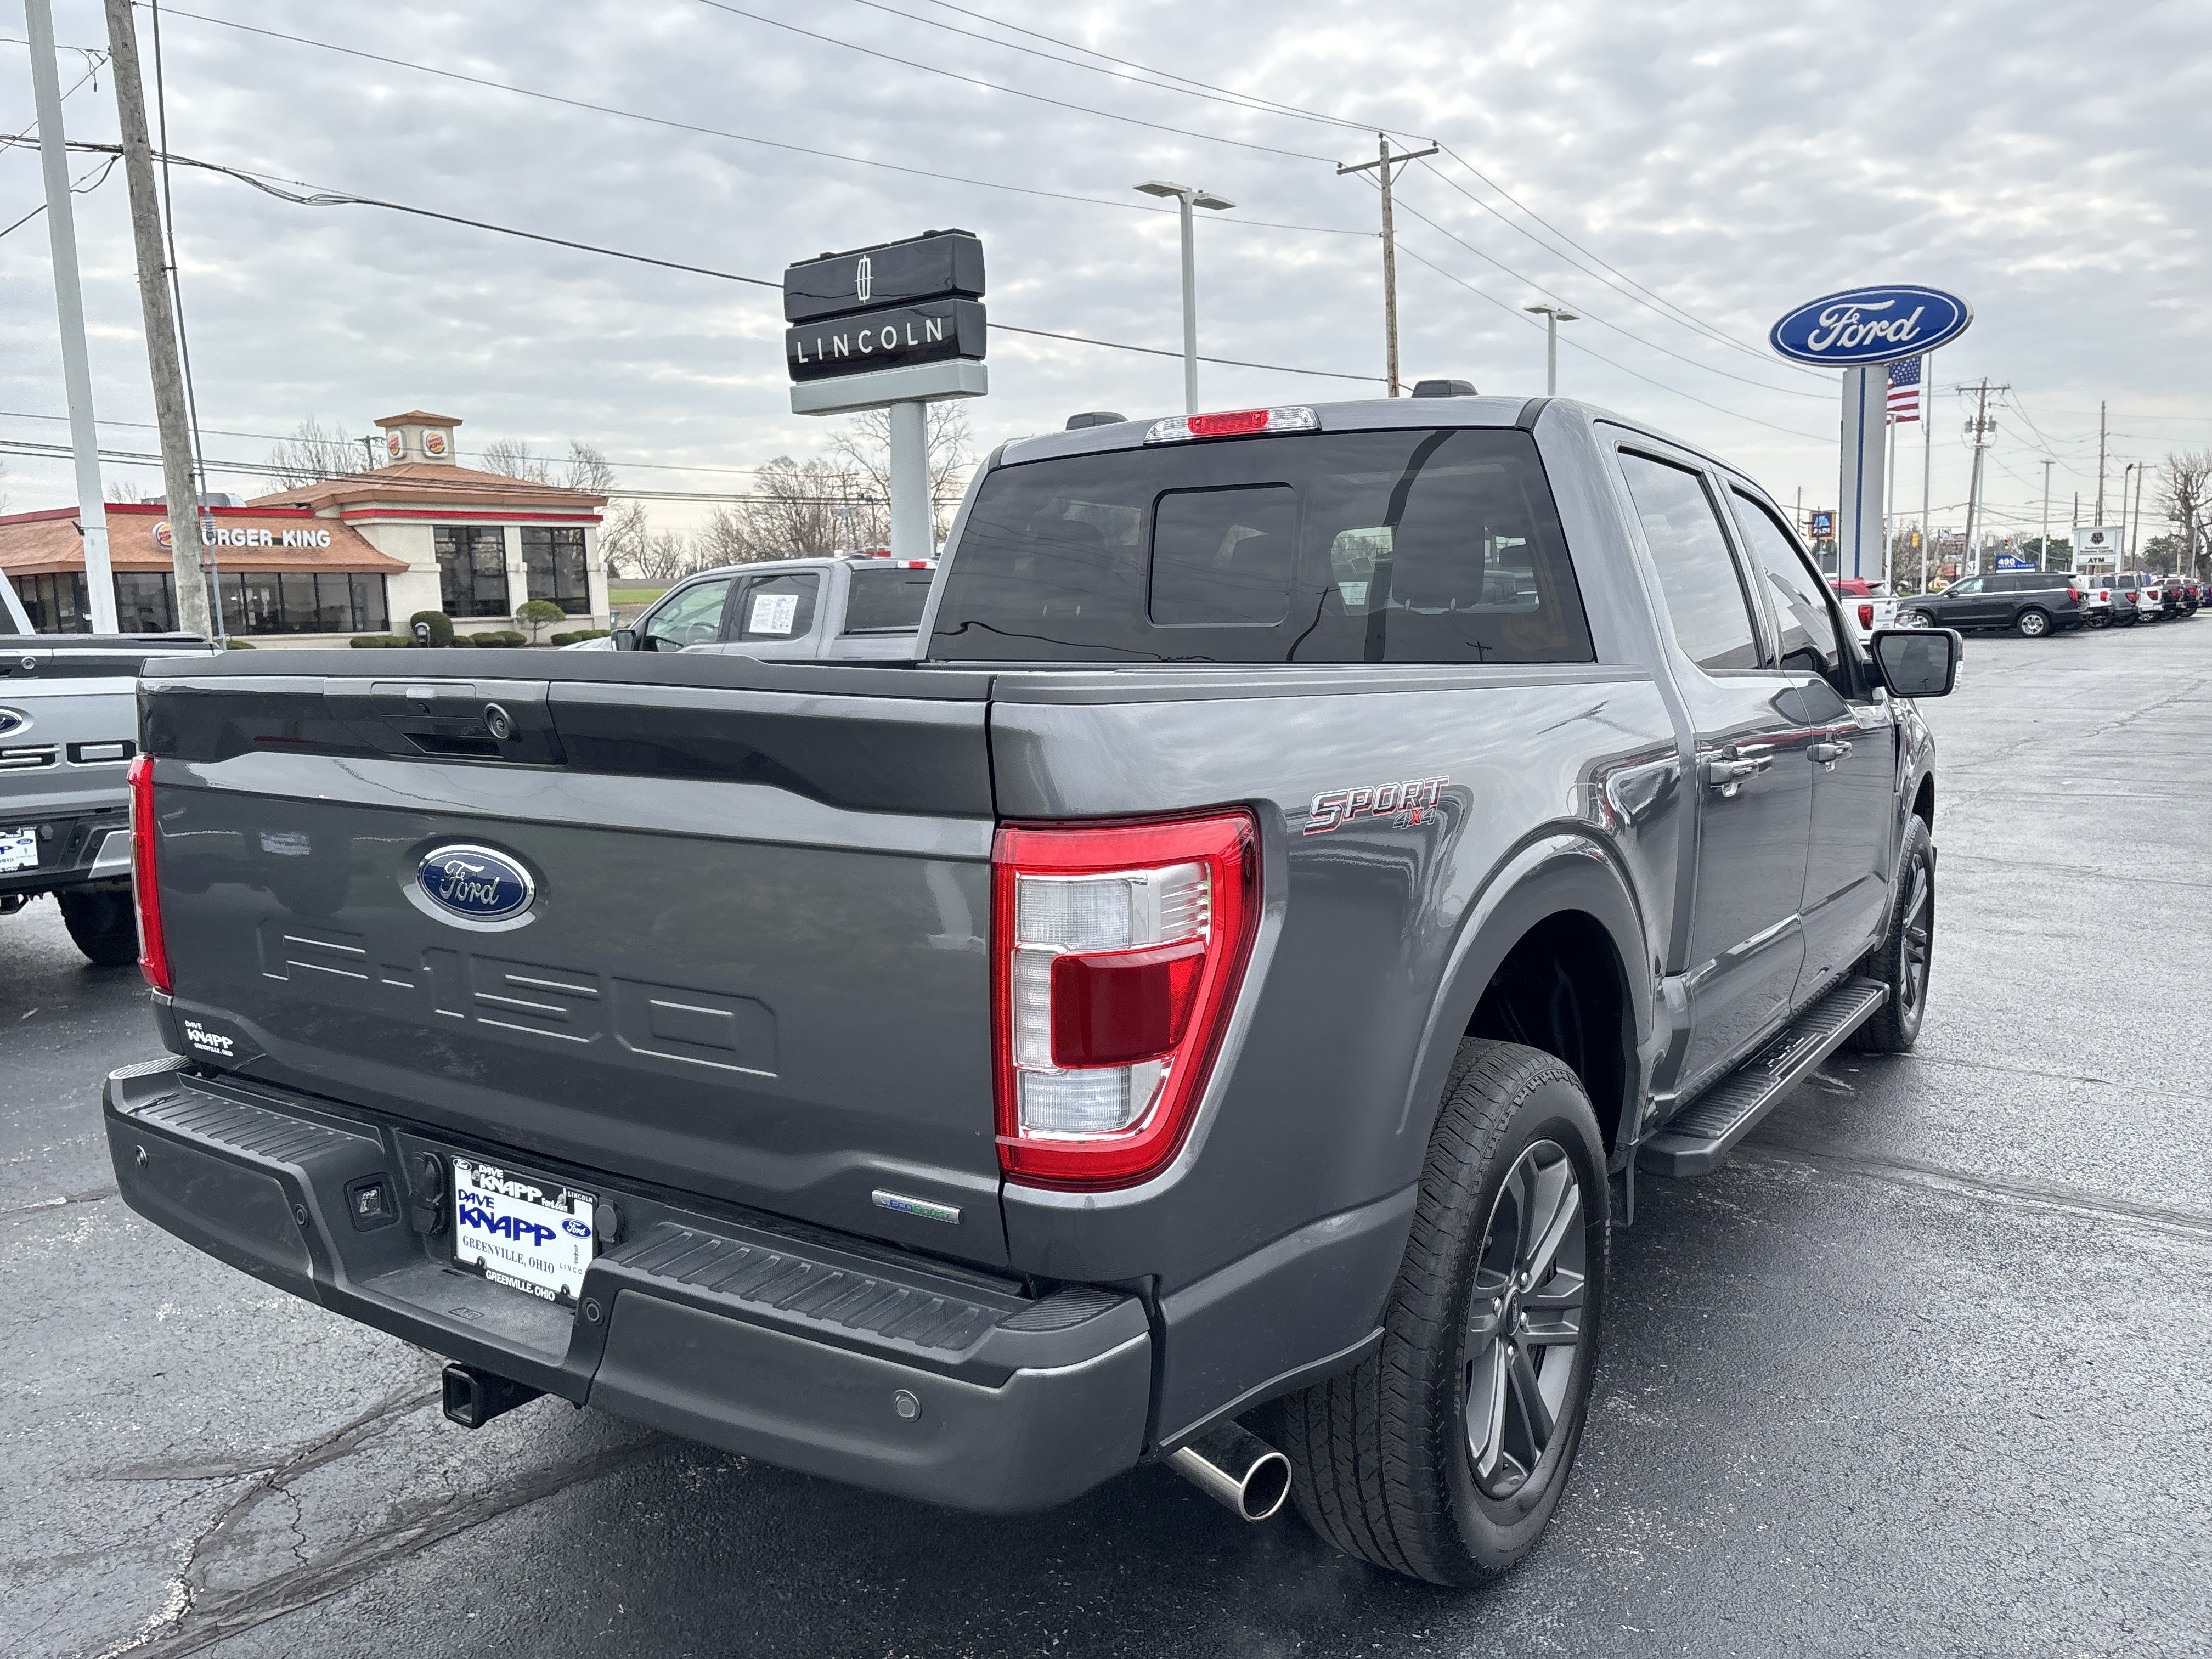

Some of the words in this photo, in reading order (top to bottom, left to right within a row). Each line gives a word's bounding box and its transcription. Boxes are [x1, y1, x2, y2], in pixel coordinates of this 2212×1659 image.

[1807, 300, 1925, 352] Ford
[797, 317, 943, 364] LINCOLN
[201, 528, 273, 548] URGER
[282, 529, 331, 548] KING
[1303, 775, 1449, 836] SPORT
[439, 860, 501, 906] Ford
[256, 917, 778, 1077] F-150
[184, 1020, 203, 1030] DAVE
[187, 1028, 233, 1049] KNAPP
[479, 1164, 504, 1178] DAVE
[458, 1189, 494, 1209] DAVE
[479, 1173, 543, 1201] KNAPP
[568, 1190, 593, 1203] LINCOLN
[541, 1198, 568, 1212] Ford.com
[459, 1204, 556, 1247] KNAPP
[462, 1235, 526, 1268] GREENVILLE,
[528, 1256, 555, 1274] OHIO
[534, 1286, 555, 1302] OHIO
